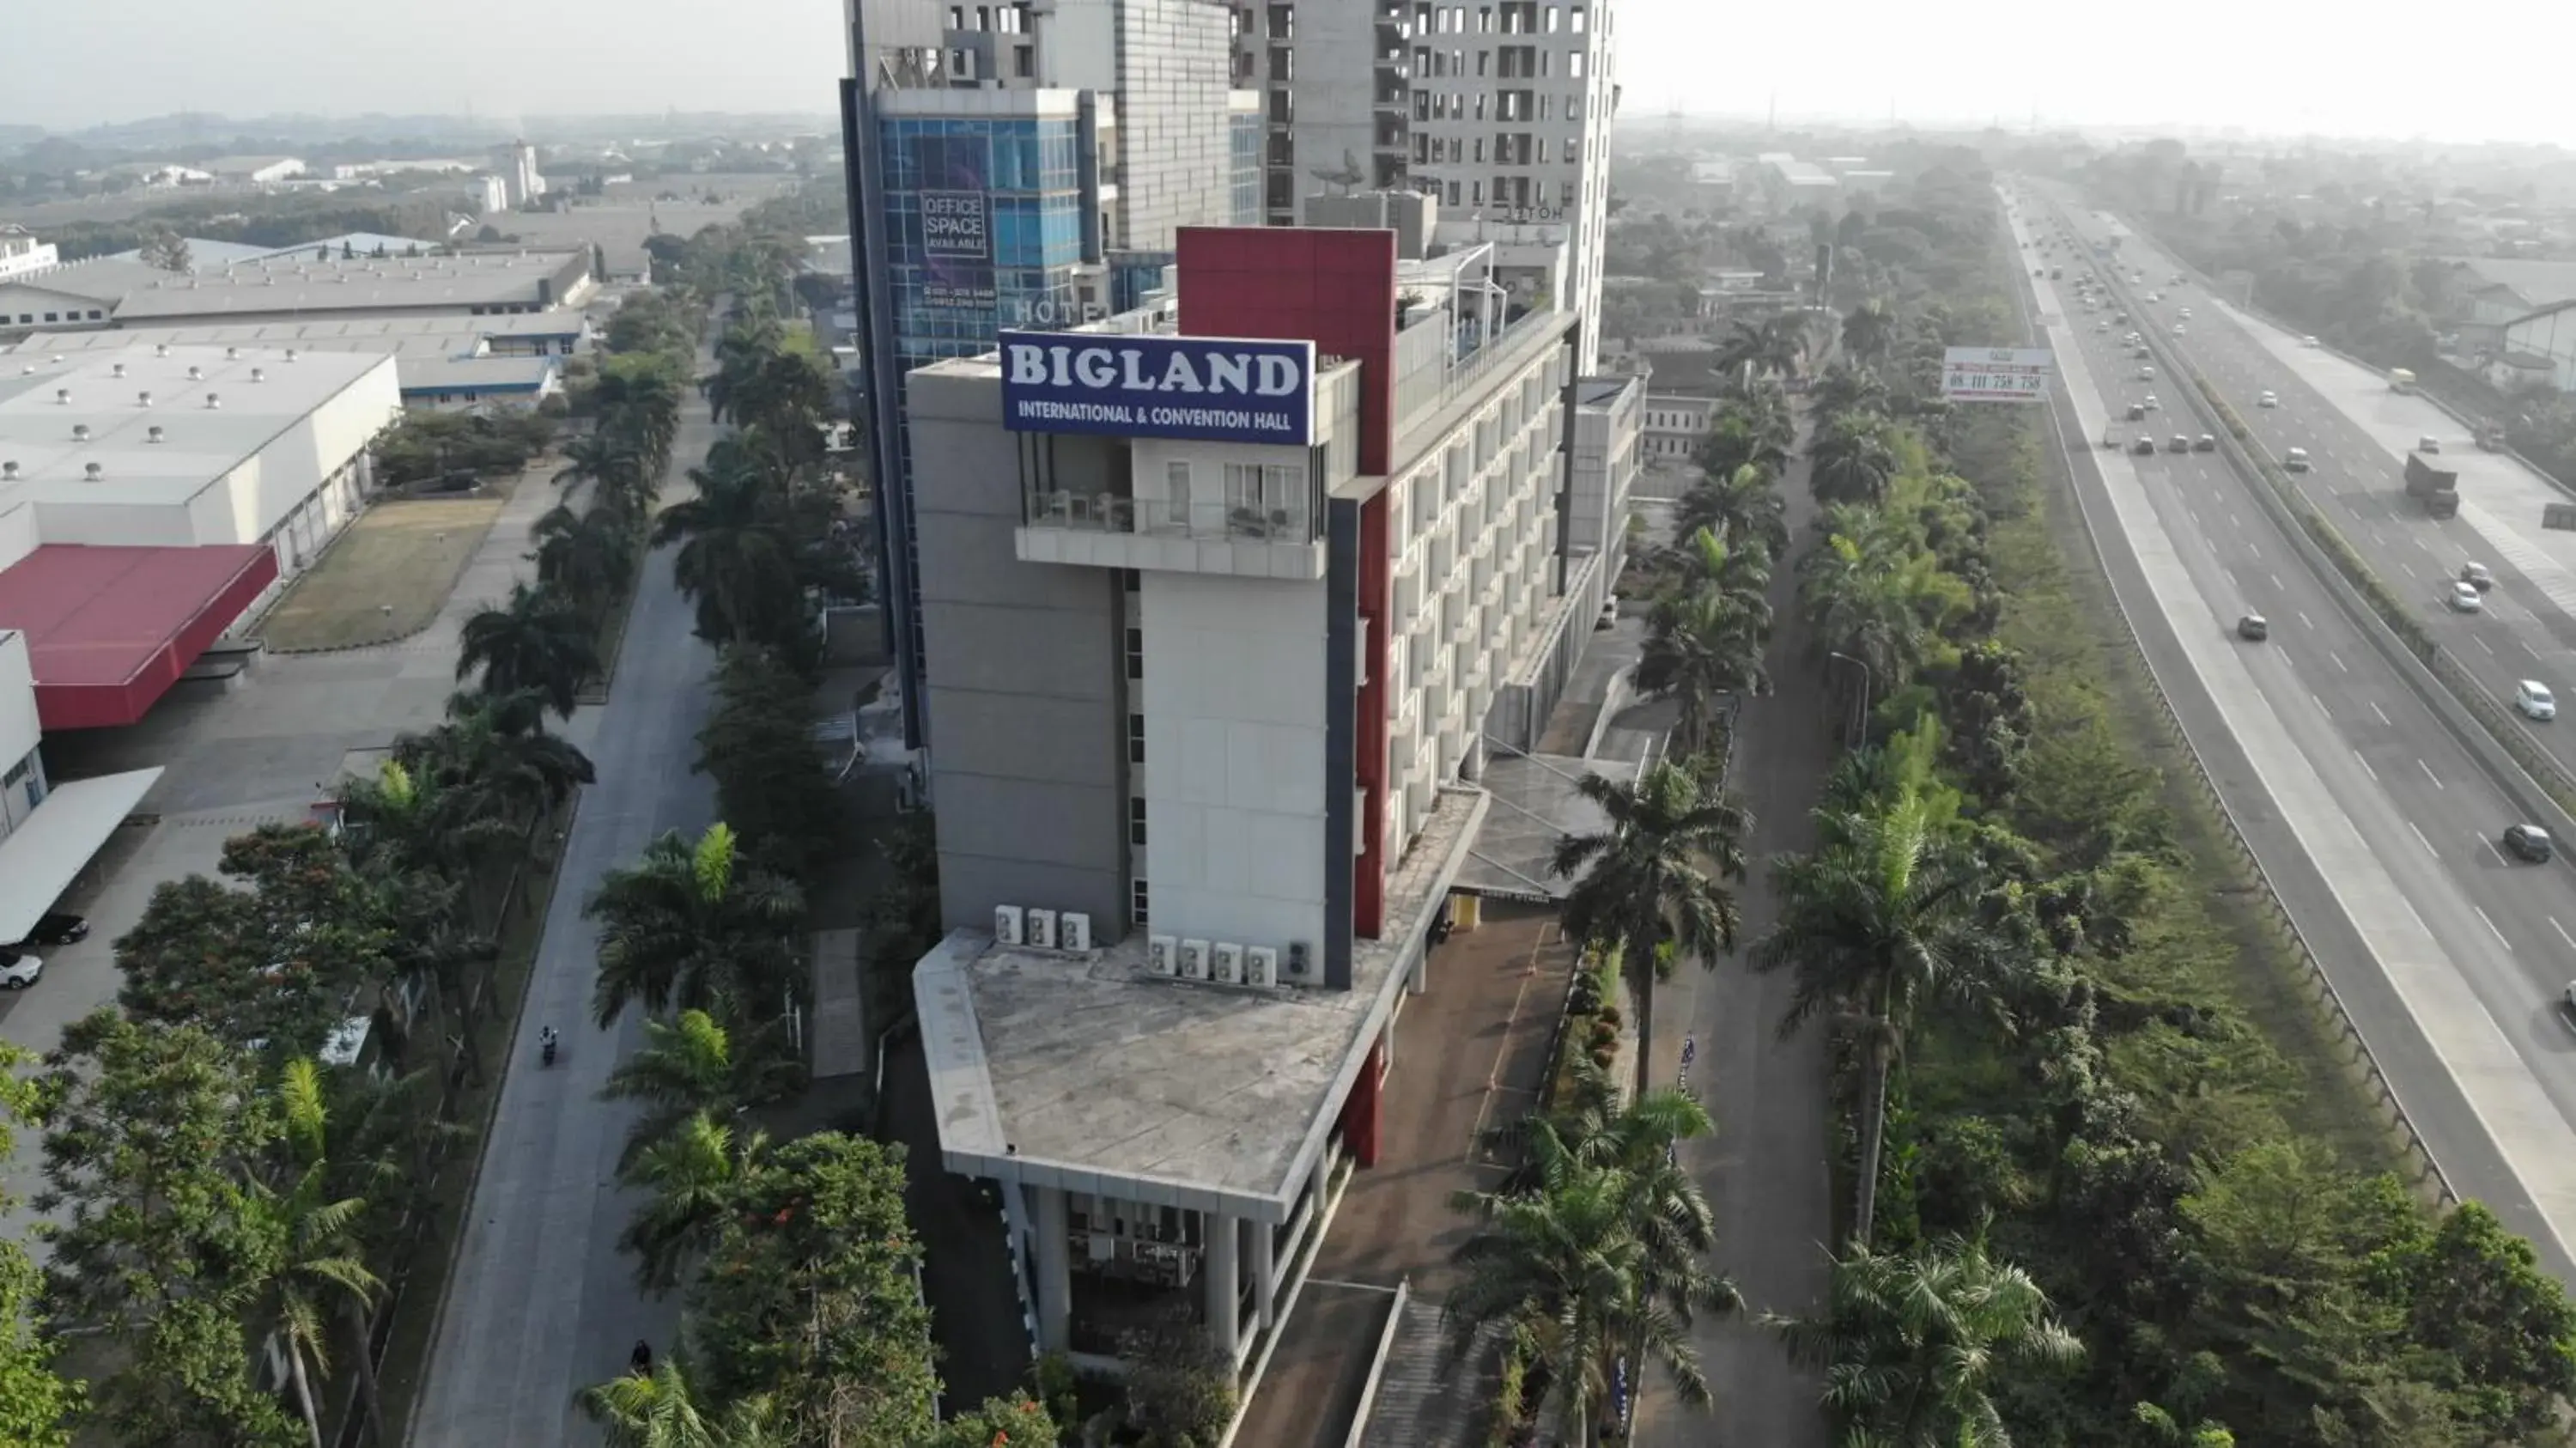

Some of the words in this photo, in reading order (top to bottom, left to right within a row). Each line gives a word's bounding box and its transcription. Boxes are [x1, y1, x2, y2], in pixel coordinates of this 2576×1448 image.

[926, 198, 981, 214] OFFICE
[927, 217, 982, 234] SPACE
[1007, 344, 1300, 396] BIGLAND
[1018, 400, 1133, 423] INTERNATIONAL
[1136, 406, 1147, 423] &
[1151, 407, 1249, 428] CONVENTION
[1255, 412, 1291, 430] HALL
